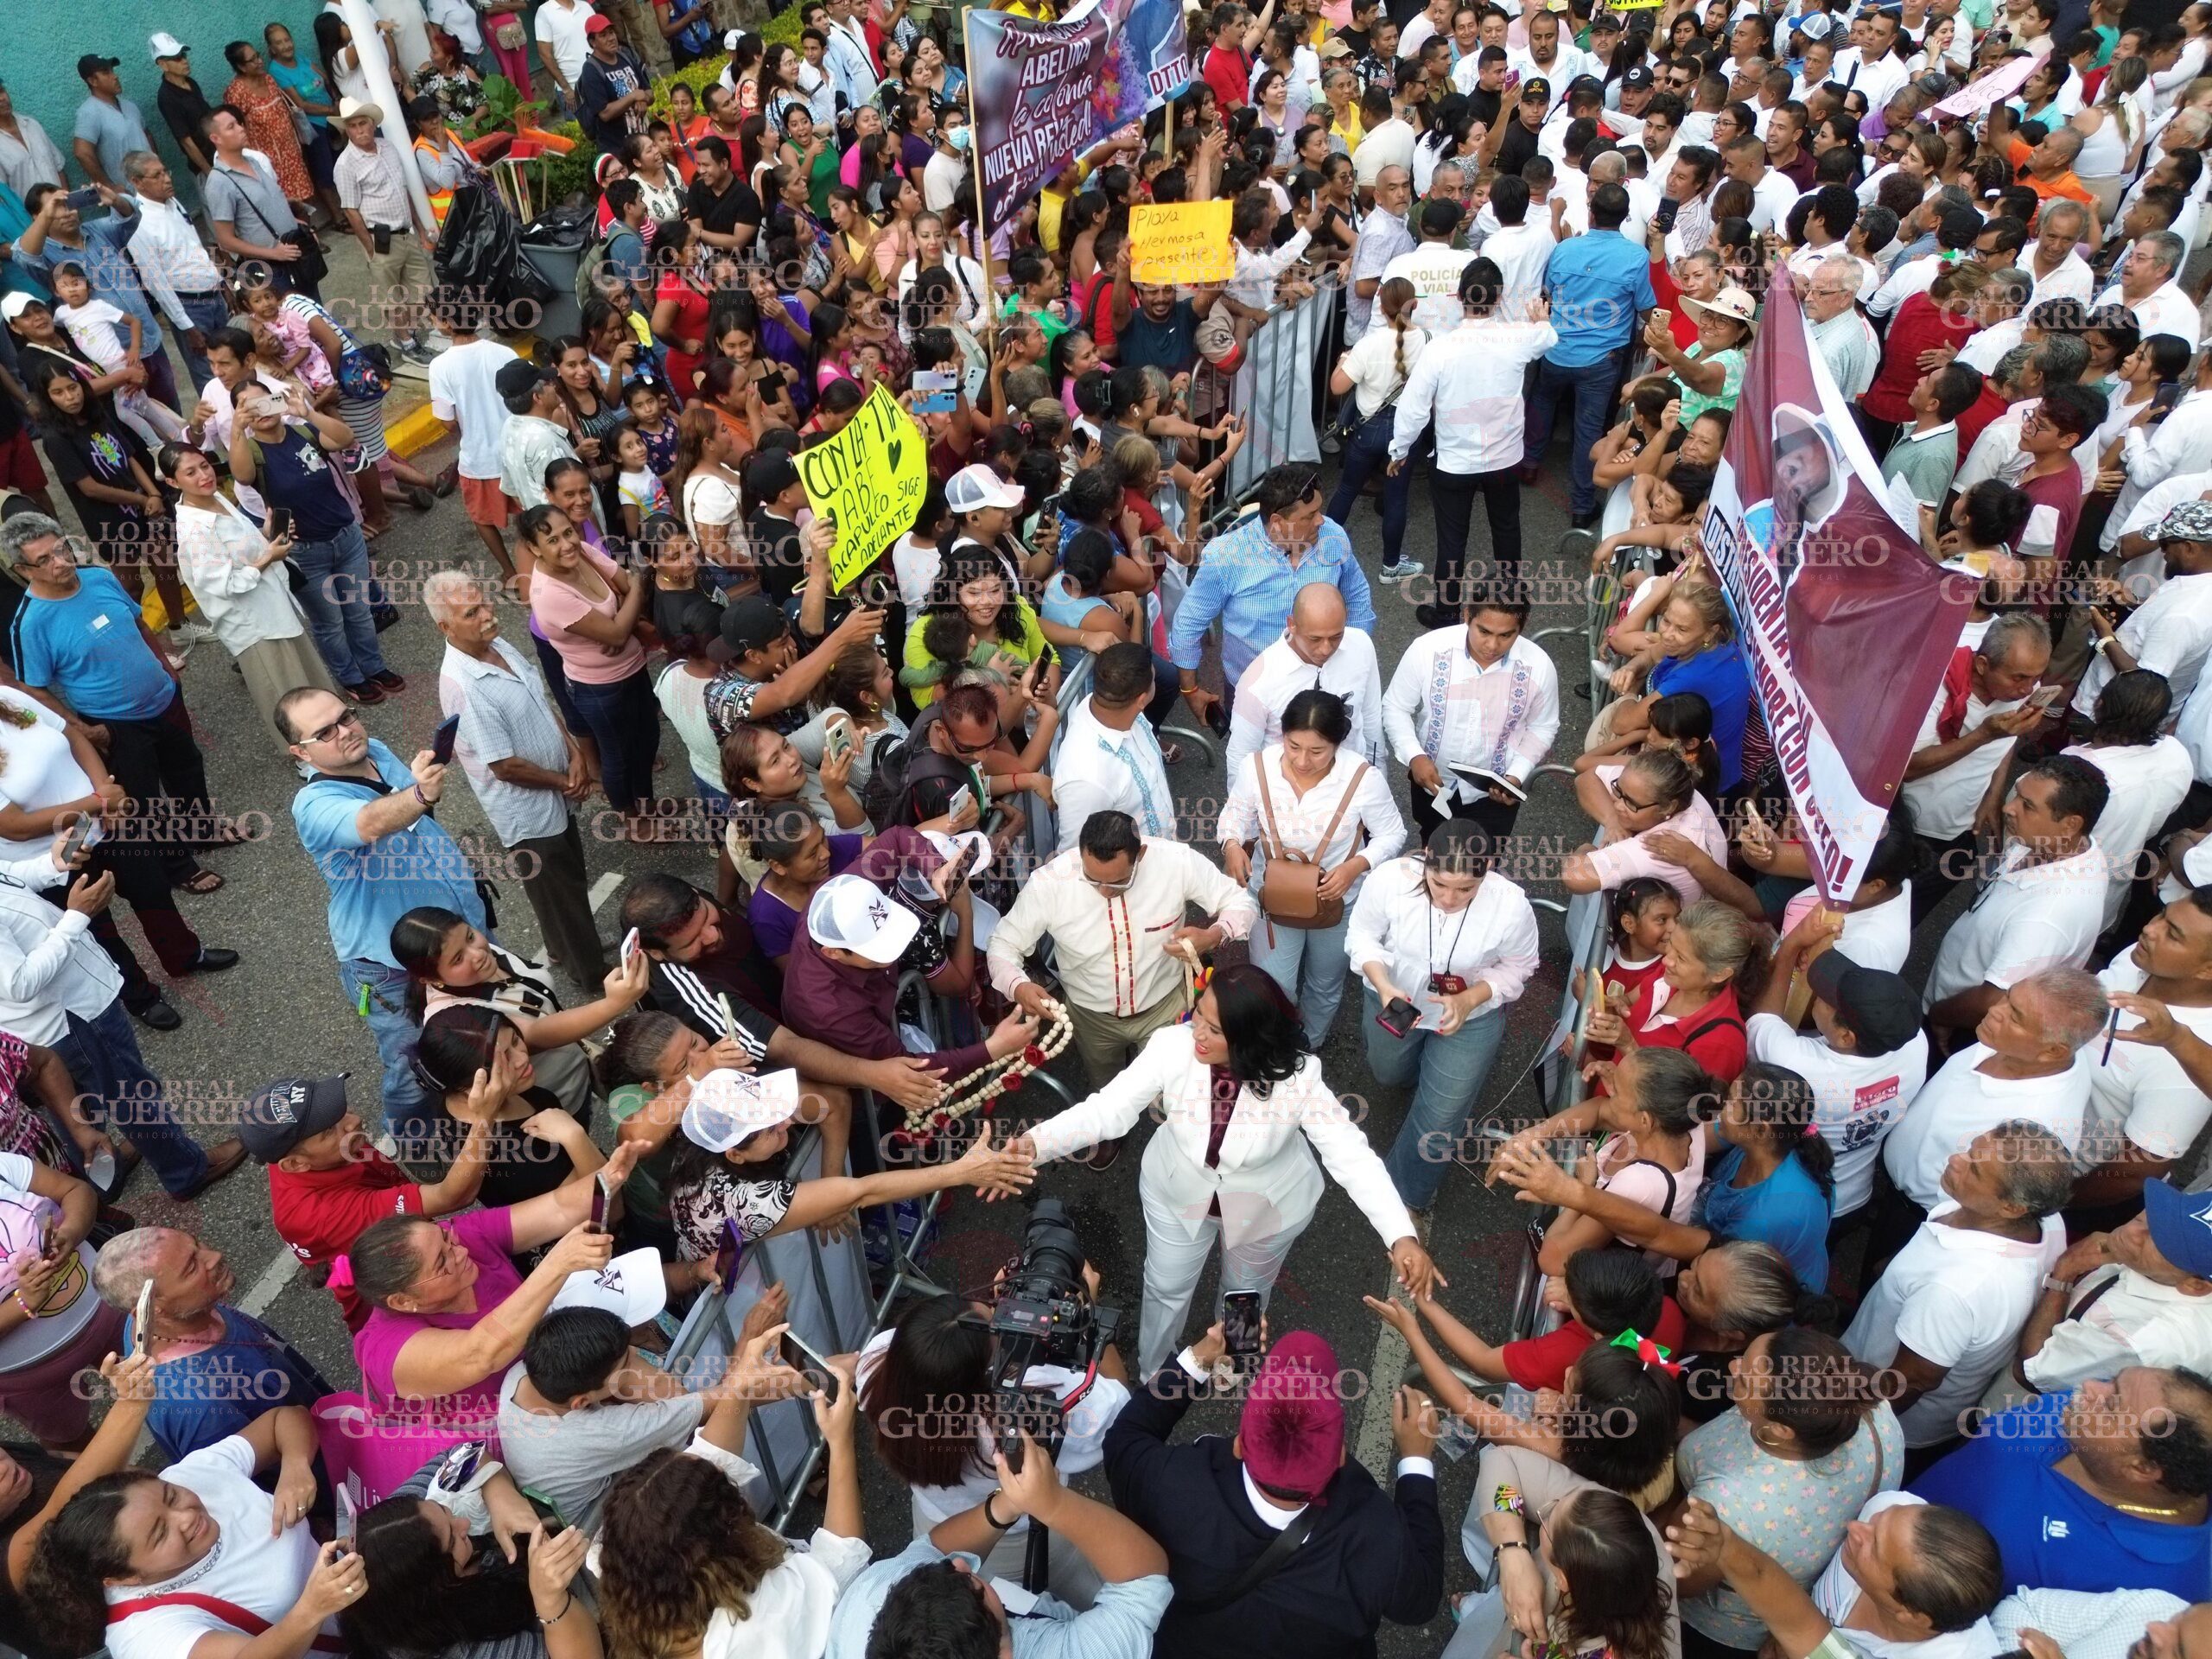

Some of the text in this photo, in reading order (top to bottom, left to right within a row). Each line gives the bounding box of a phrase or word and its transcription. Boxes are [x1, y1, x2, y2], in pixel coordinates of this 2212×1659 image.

[606, 66, 635, 82] USA
[1021, 37, 1091, 87] ABELINA
[1033, 71, 1092, 120] colonia
[984, 135, 1034, 186] NUEVA
[1135, 208, 1179, 232] Playa
[1410, 267, 1463, 282] POLICÍA
[1423, 283, 1451, 293] VIAL
[804, 435, 850, 499] CON
[832, 476, 920, 583] ACAPULCO SIGE
[860, 503, 912, 566] ADELANTE
[1777, 721, 1811, 796] CON
[290, 1086, 306, 1104] NY
